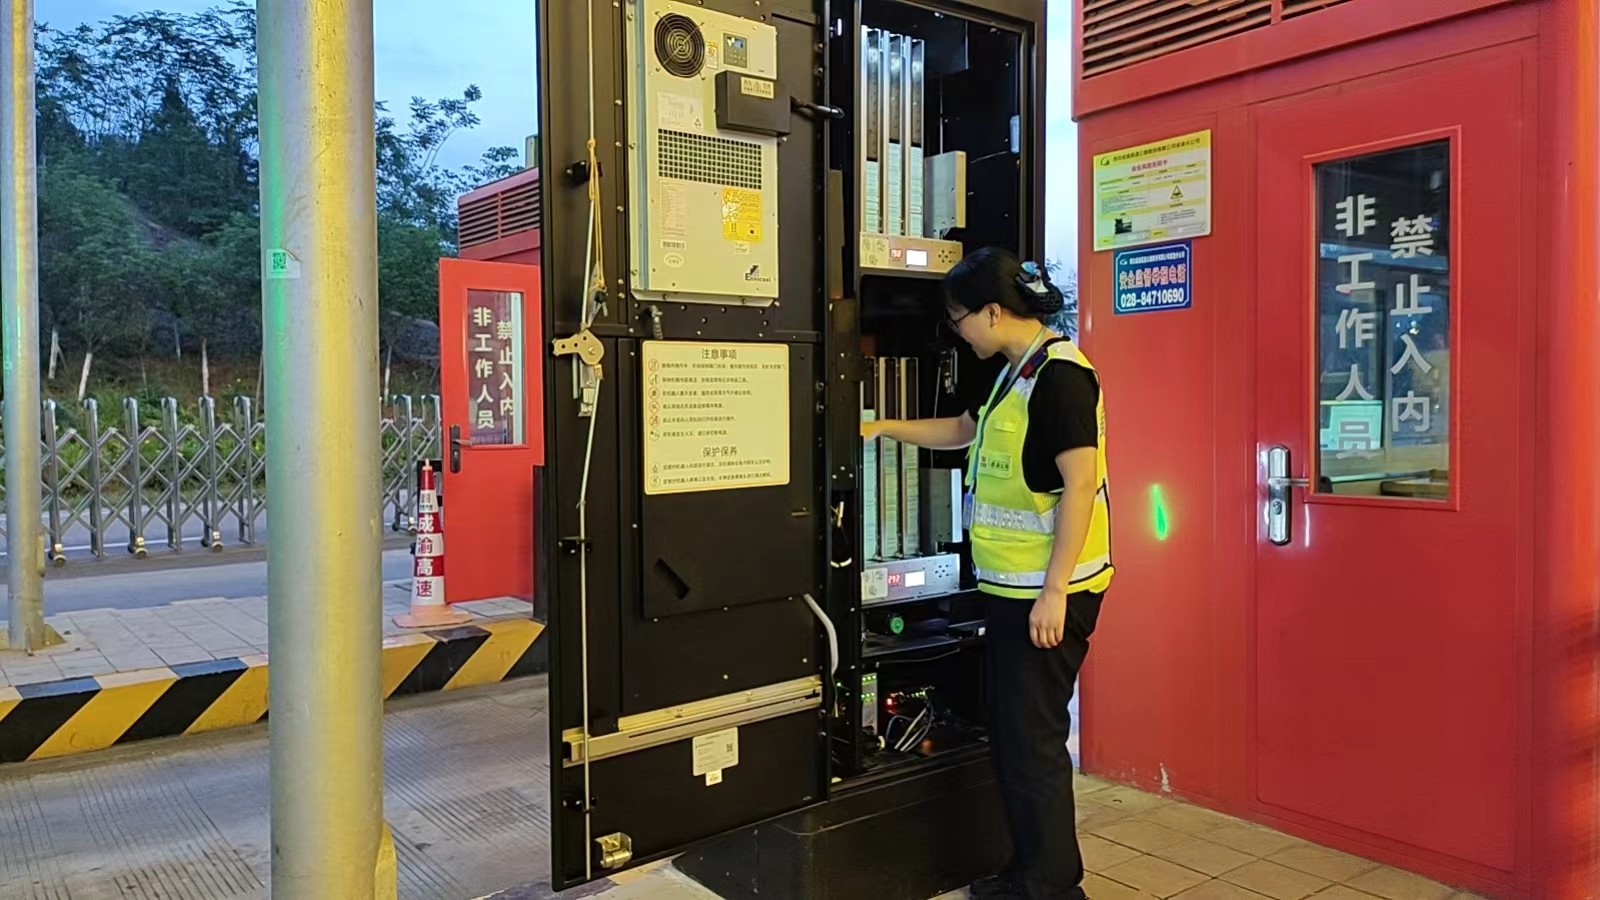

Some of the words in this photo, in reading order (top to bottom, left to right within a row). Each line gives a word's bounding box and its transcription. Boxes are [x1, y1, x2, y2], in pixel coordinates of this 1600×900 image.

[1119, 263, 1186, 291] 安全监督举报电话
[1121, 287, 1184, 308] 028-84710690
[701, 348, 738, 360] 注意事项
[1335, 194, 1377, 459] 非工作人员
[1390, 214, 1433, 432] 禁止入内
[473, 307, 494, 429] 非工作人员
[497, 321, 514, 416] 禁止入内
[702, 446, 738, 458] 保护保养
[416, 514, 435, 597] 成渝高速
